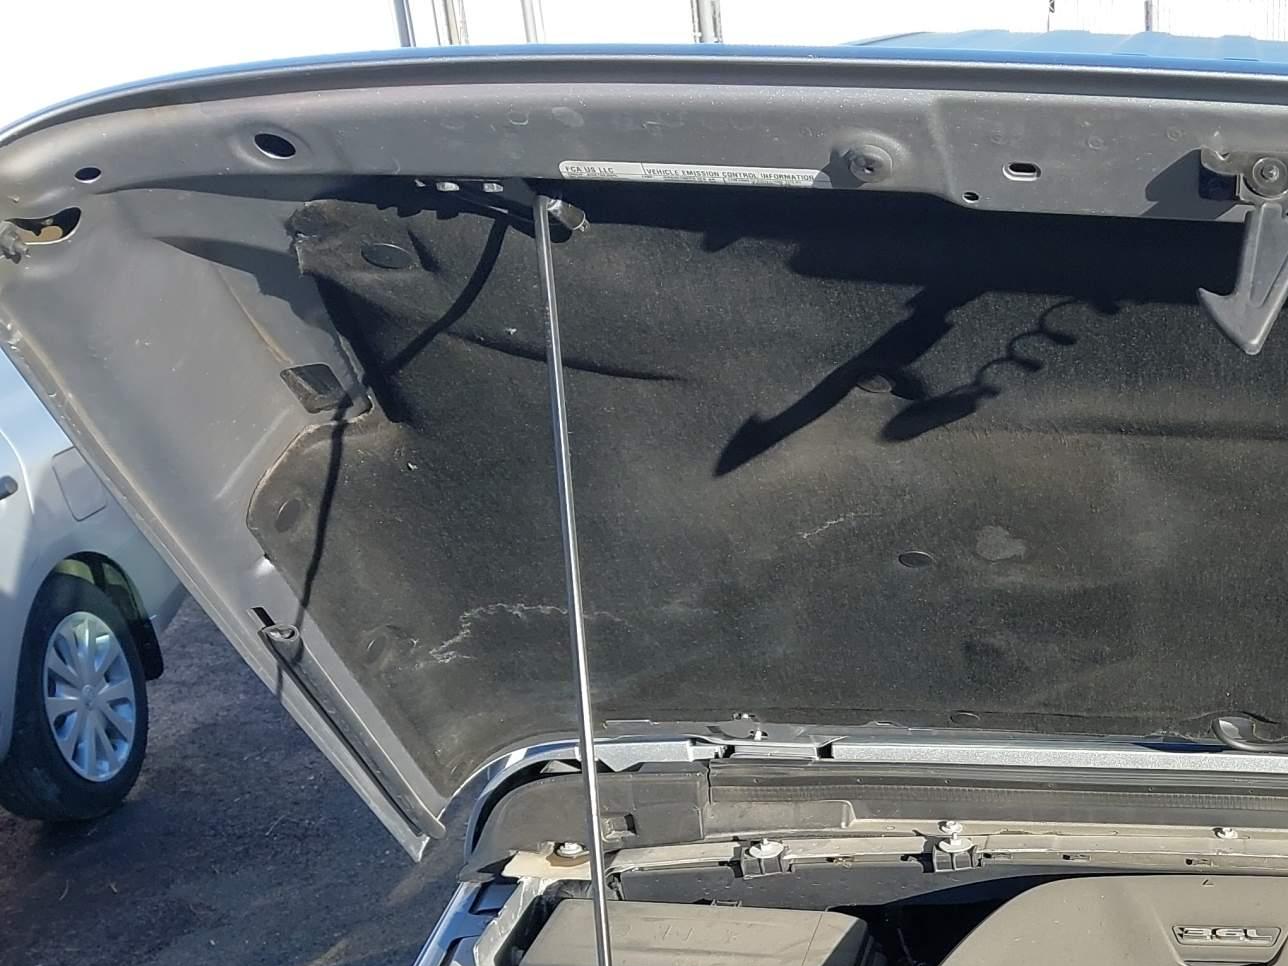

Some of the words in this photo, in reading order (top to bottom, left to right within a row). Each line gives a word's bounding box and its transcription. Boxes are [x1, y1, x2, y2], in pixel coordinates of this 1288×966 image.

[646, 168, 679, 176] VEHICLE
[682, 170, 719, 178] EMISSION
[722, 171, 756, 179] CONTROL
[761, 173, 815, 181] INFORMATION
